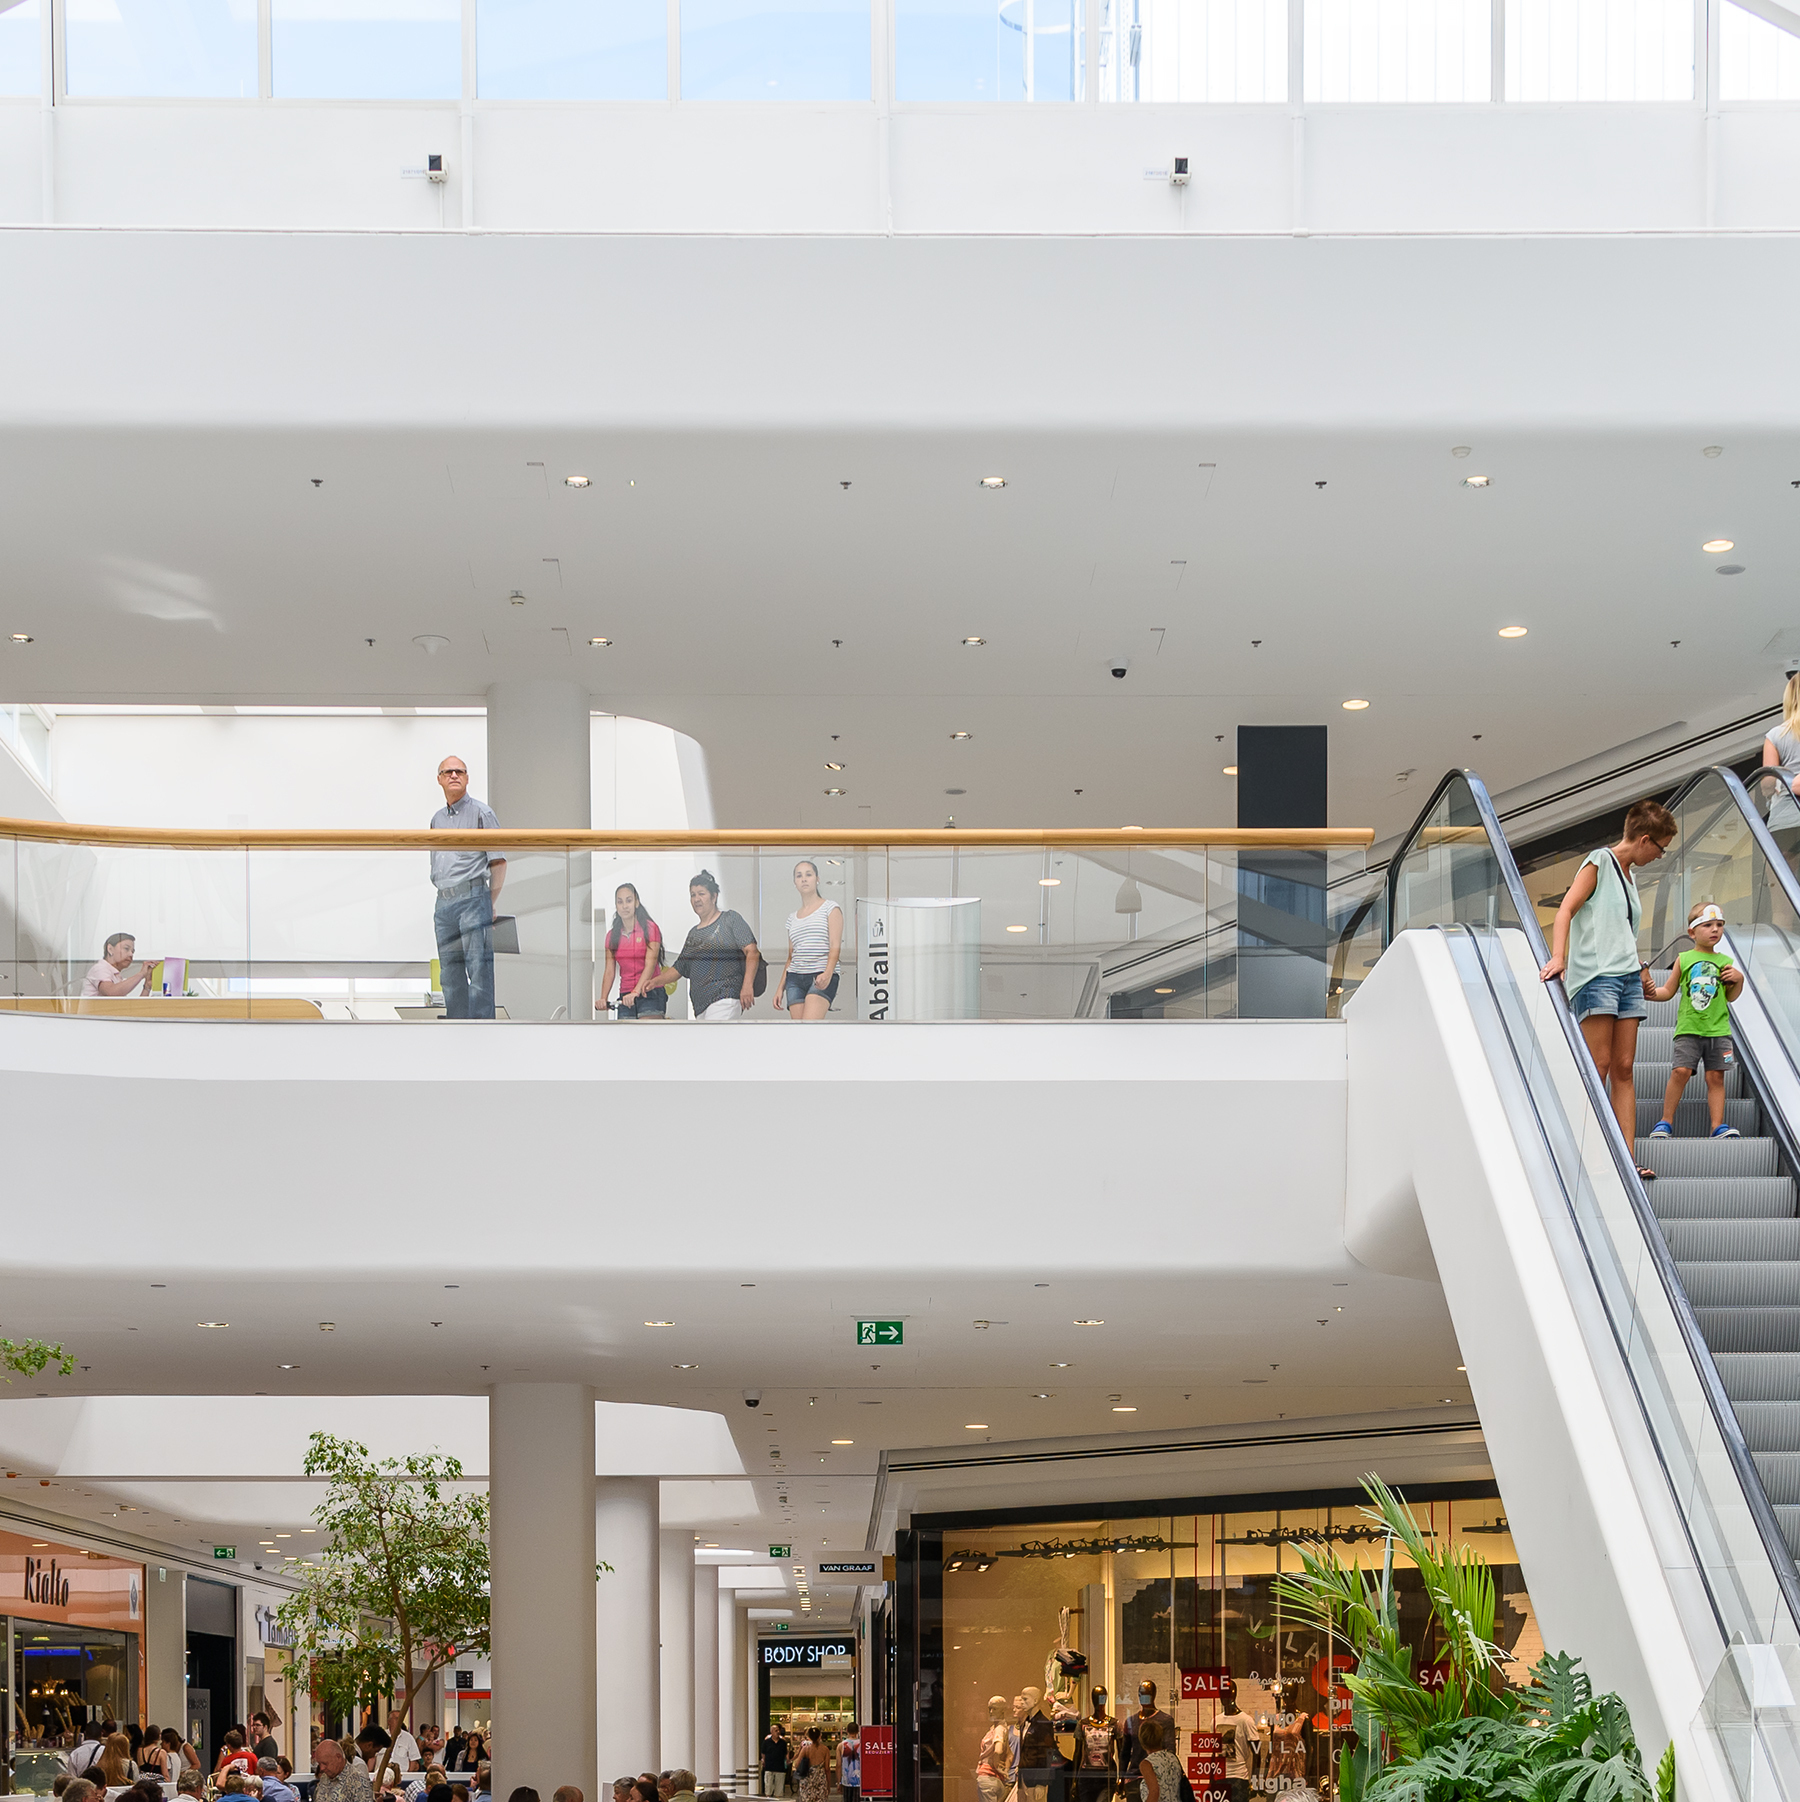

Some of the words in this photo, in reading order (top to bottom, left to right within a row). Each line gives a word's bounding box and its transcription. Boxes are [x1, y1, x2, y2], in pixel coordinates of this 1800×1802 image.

[868, 943, 889, 1020] Abfall
[24, 1556, 69, 1607] Rialto
[1249, 1613, 1319, 1661] VILA
[764, 1645, 805, 1663] BODY
[1183, 1675, 1230, 1691] SALE
[865, 1741, 893, 1750] SALE
[1193, 1737, 1220, 1749] -20%
[1251, 1740, 1307, 1755] VILA
[1191, 1762, 1222, 1775] -30%
[1251, 1775, 1307, 1794] tigha
